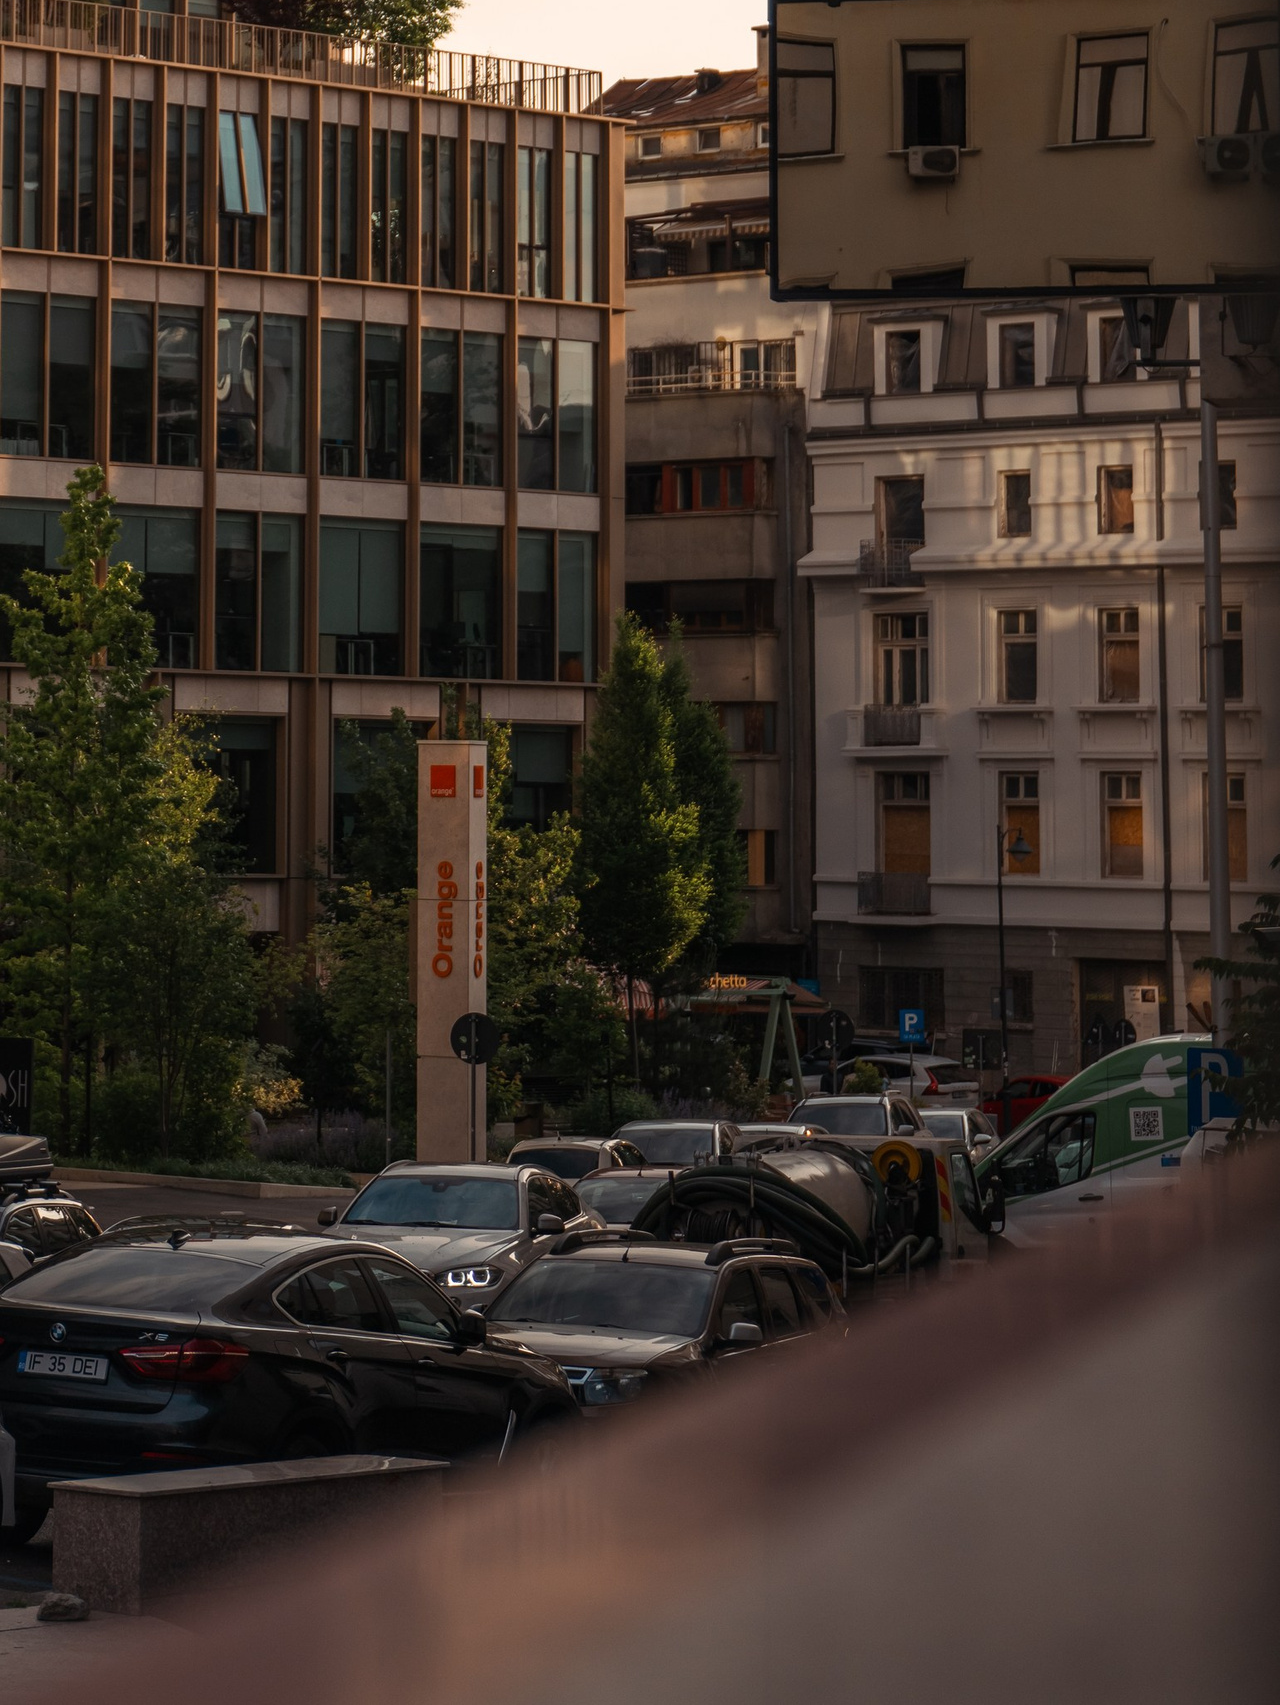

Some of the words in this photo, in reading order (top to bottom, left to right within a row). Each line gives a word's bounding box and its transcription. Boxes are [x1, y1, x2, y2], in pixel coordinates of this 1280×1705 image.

[432, 861, 457, 978] Orange
[474, 861, 484, 978] Orange
[704, 971, 747, 989] chetta
[904, 1013, 918, 1032] P
[1200, 1052, 1229, 1124] P
[28, 1353, 43, 1370] IF
[48, 1356, 66, 1373] 35
[72, 1357, 99, 1376] DEI
